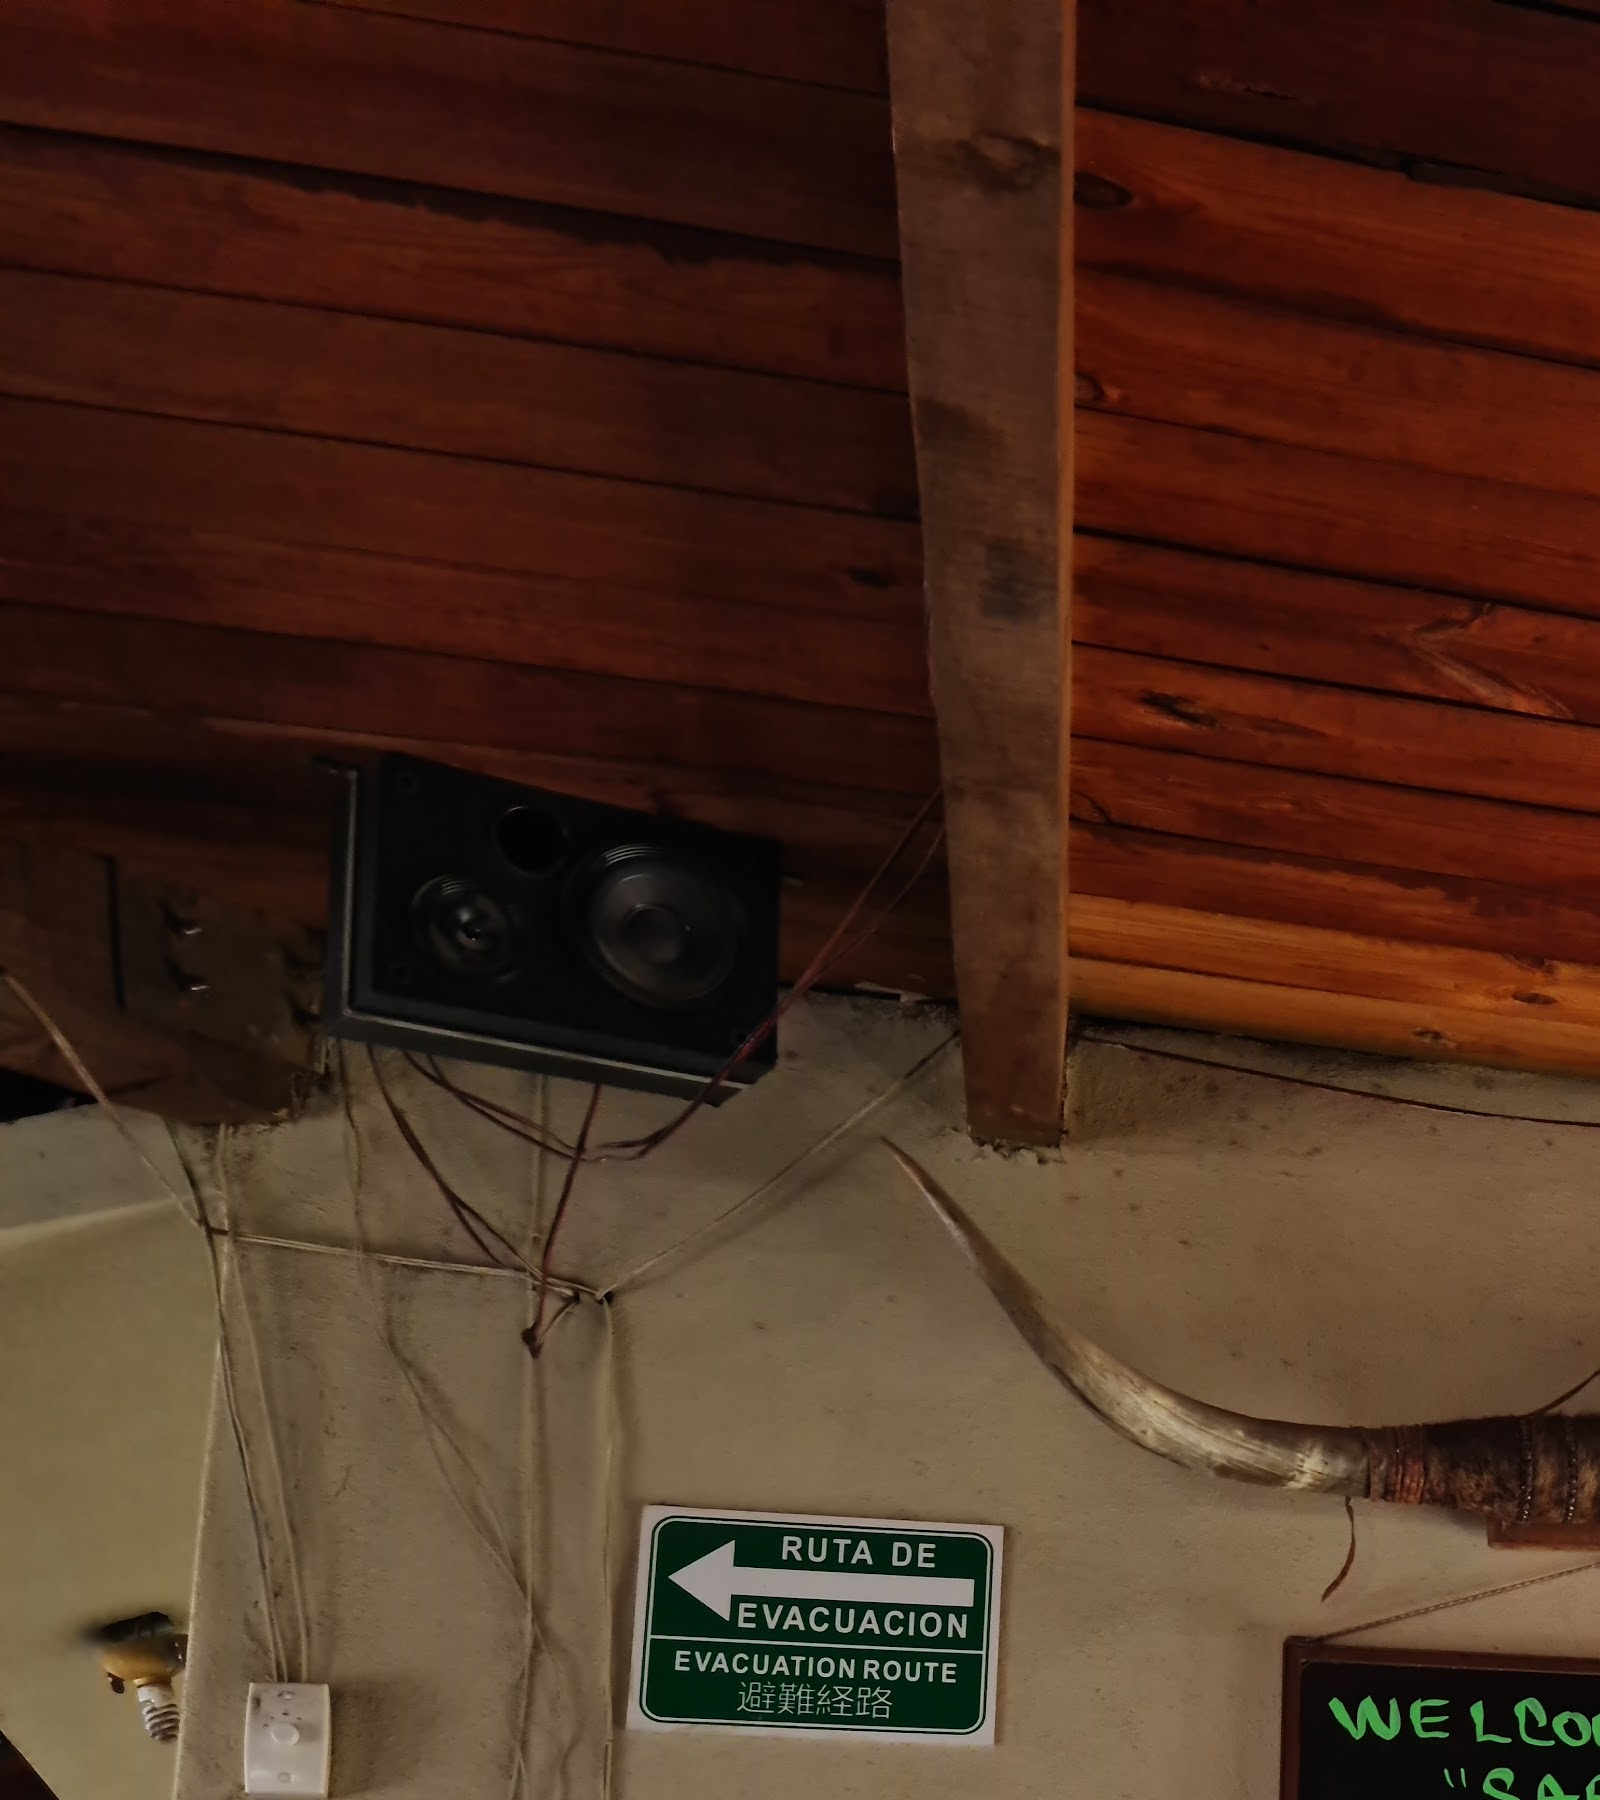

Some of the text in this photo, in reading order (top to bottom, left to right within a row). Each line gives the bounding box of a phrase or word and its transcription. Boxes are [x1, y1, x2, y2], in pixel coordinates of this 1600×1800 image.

[781, 1535, 936, 1569] RUTA DE
[736, 1602, 968, 1639] EVACUACION
[674, 1650, 957, 1684] EVACUATION ROUTE
[736, 1681, 893, 1719] 避難経路
